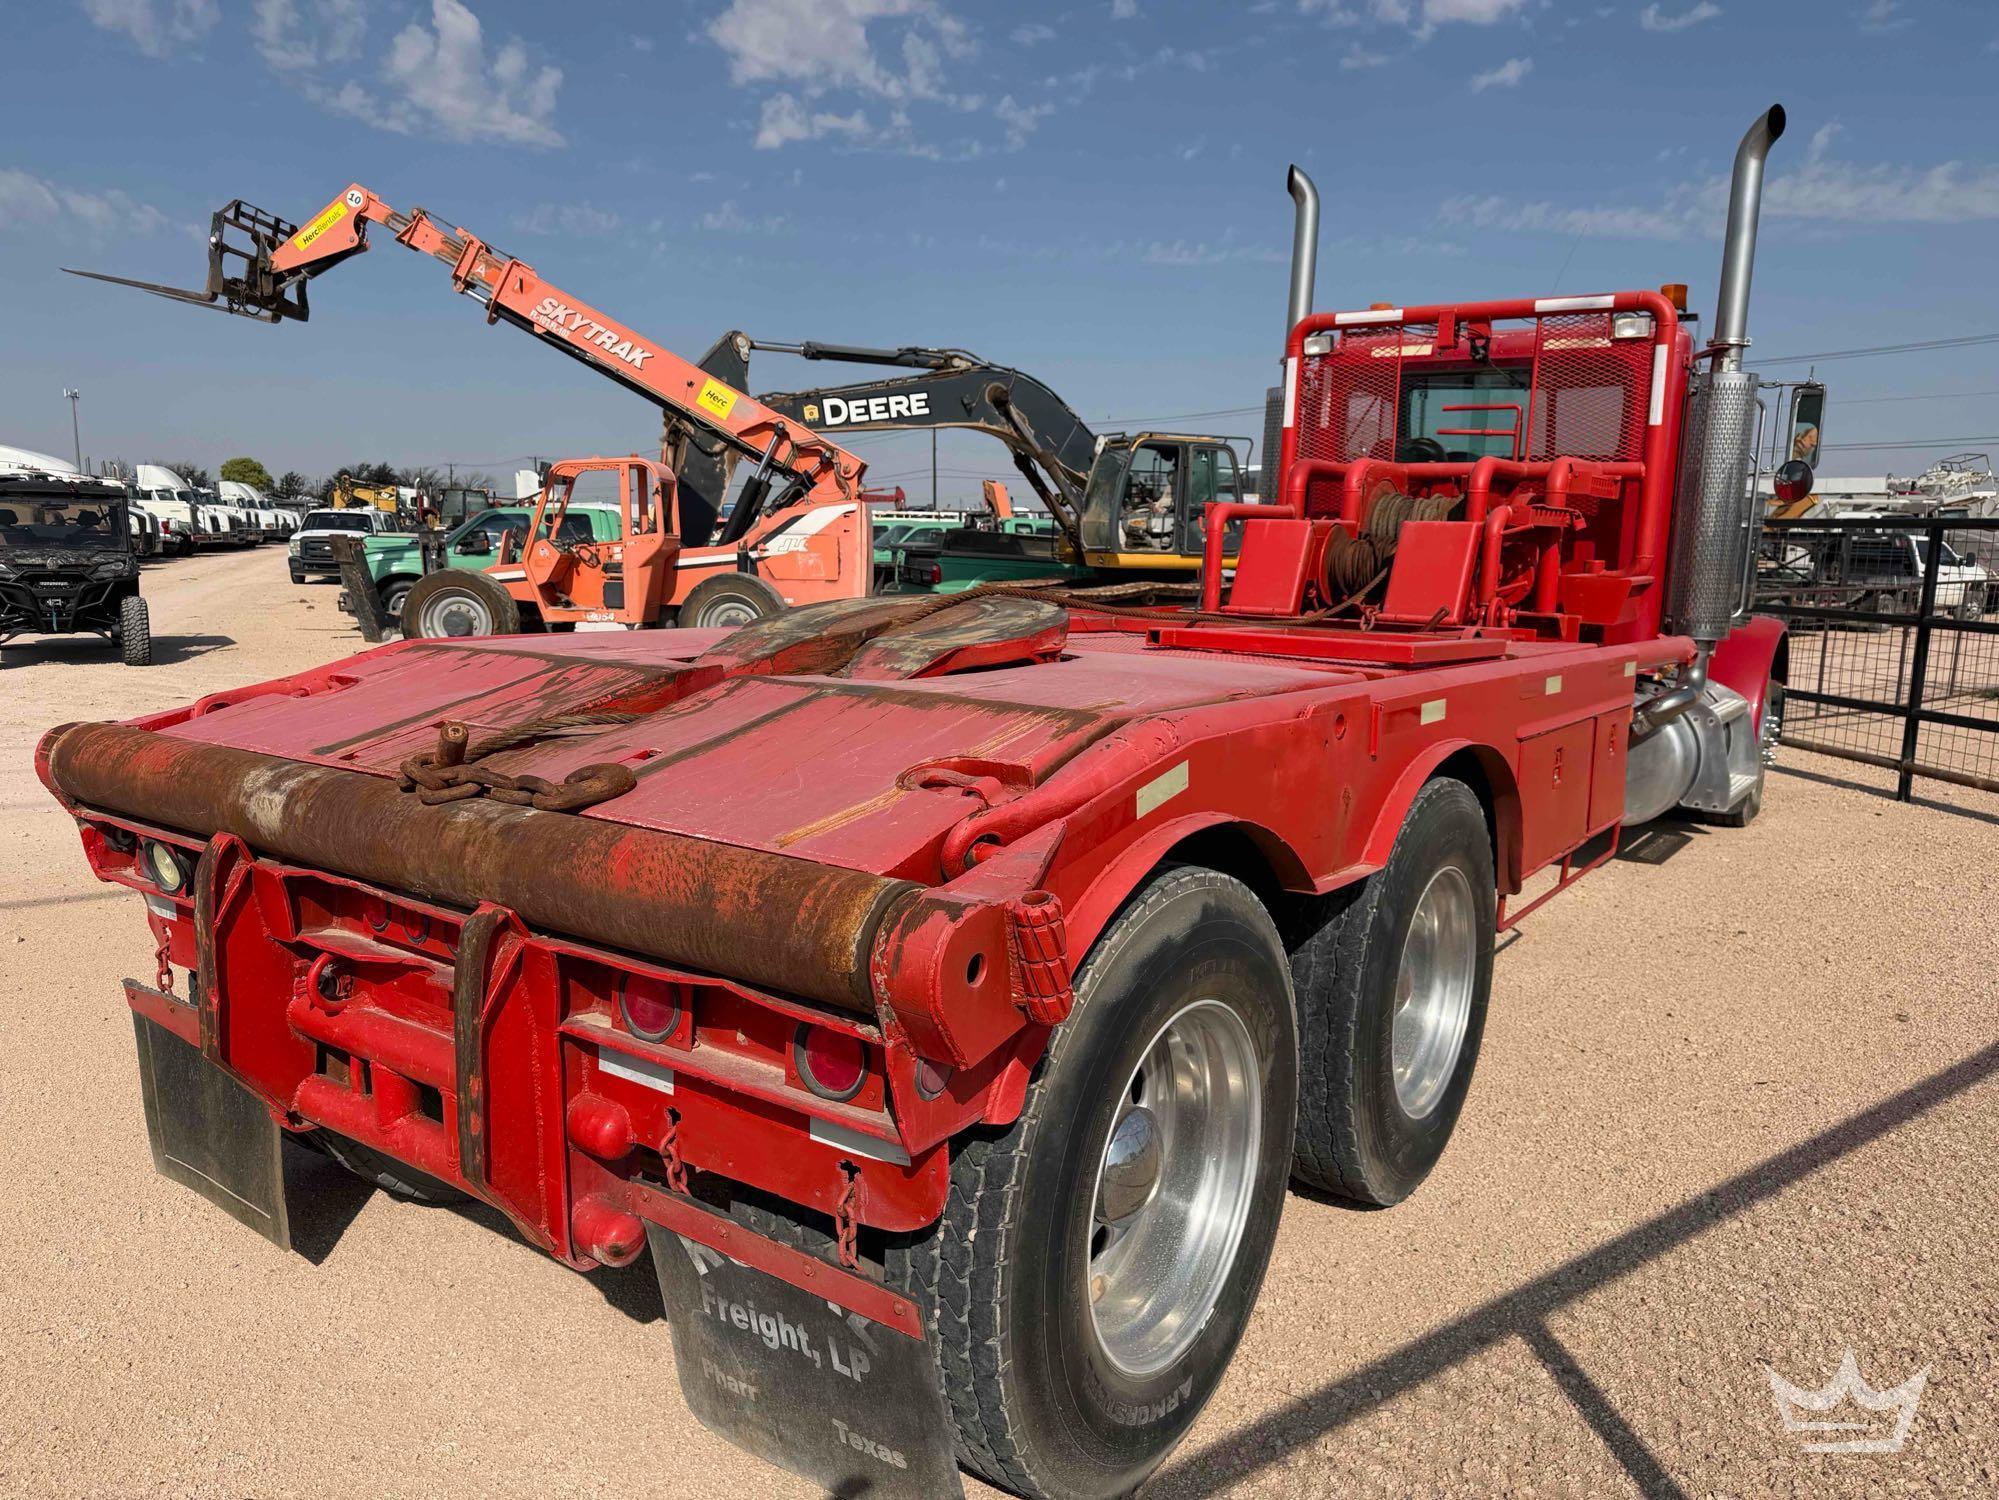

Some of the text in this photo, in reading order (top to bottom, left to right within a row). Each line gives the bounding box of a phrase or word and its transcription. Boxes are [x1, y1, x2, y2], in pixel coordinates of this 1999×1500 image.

[347, 193, 362, 205] 10
[536, 296, 655, 371] SKYTRAK
[706, 390, 728, 407] Herc
[822, 392, 930, 426] DEERE
[700, 1279, 822, 1369] Freight,
[828, 1335, 871, 1383] LP
[702, 1356, 759, 1401] Pharr
[832, 1417, 908, 1470] Texas
